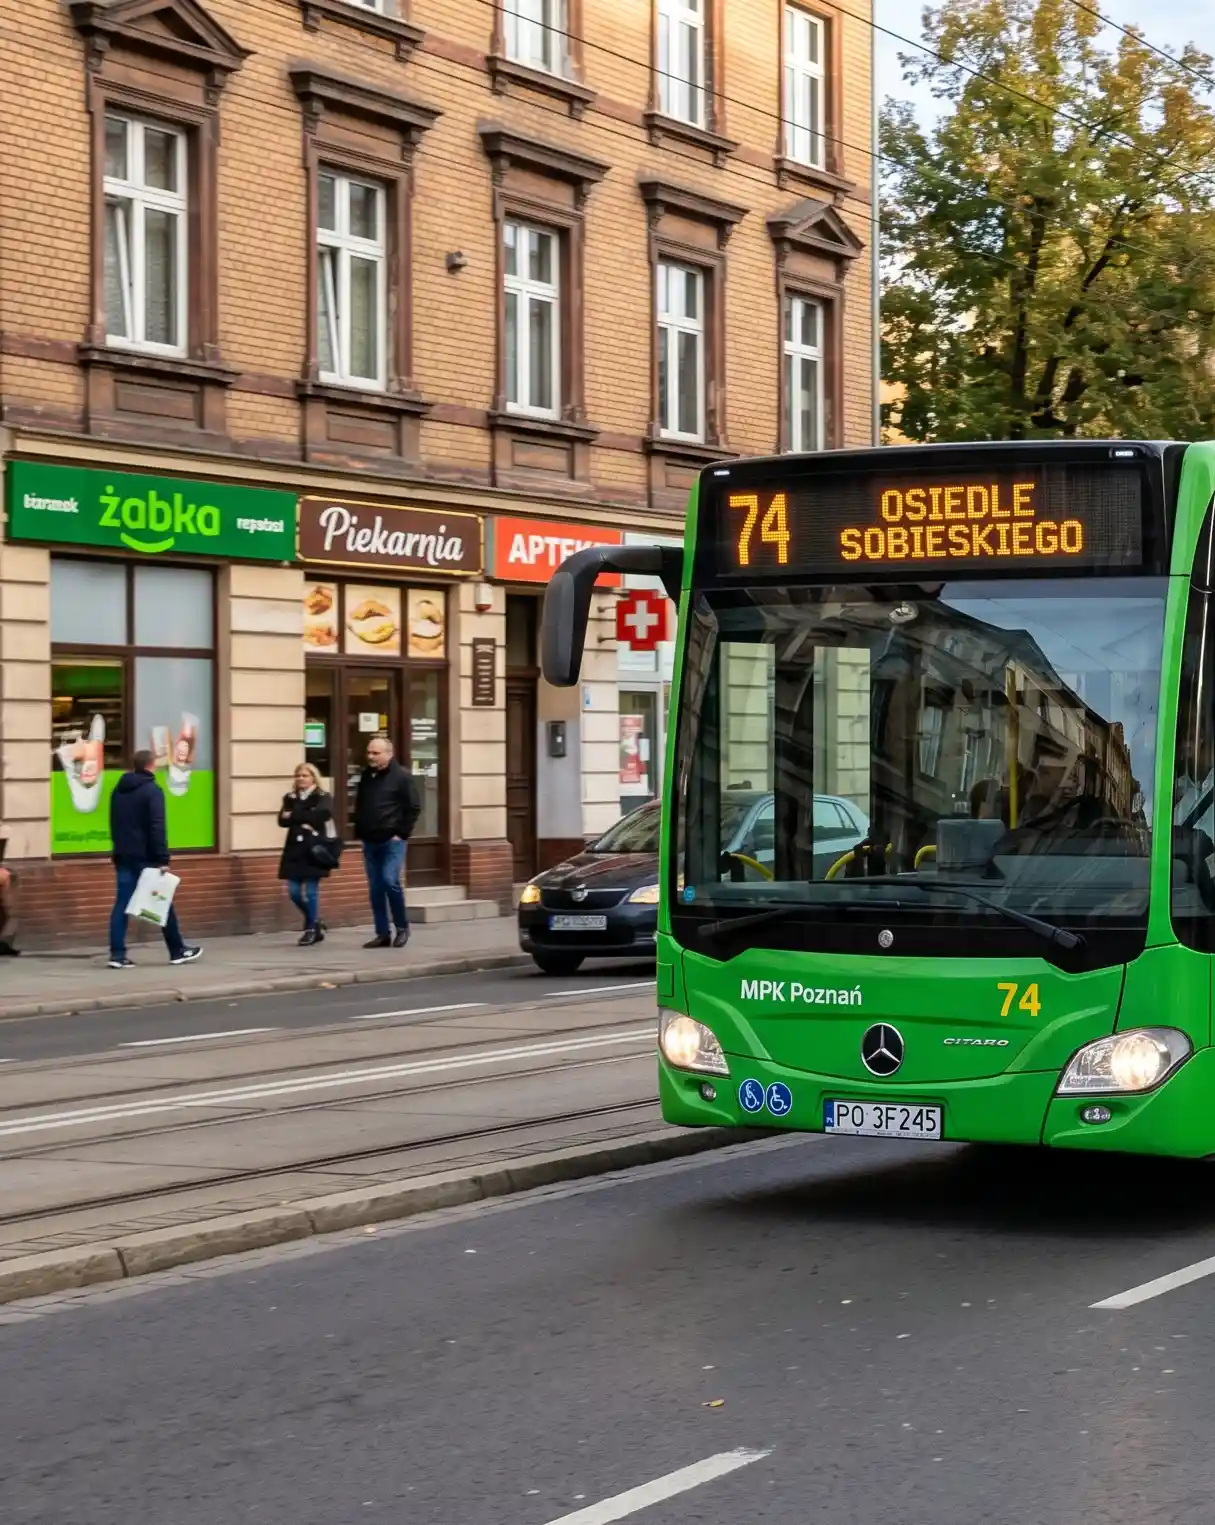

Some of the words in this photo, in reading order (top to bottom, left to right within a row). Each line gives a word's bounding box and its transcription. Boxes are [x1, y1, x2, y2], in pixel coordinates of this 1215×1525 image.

[99, 485, 221, 536] żabka
[881, 483, 1035, 522] OSIEDLE
[319, 506, 463, 565] Piekarnia
[729, 493, 790, 565] 74
[840, 520, 1083, 560] SOBIESKIEGO
[508, 533, 609, 567] APTE
[740, 979, 786, 1002] MPK
[790, 982, 862, 1006] Poznań
[997, 982, 1042, 1017] 74
[943, 1038, 1009, 1046] CITARO
[836, 1103, 864, 1128] PO
[872, 1105, 937, 1133] 3F245
